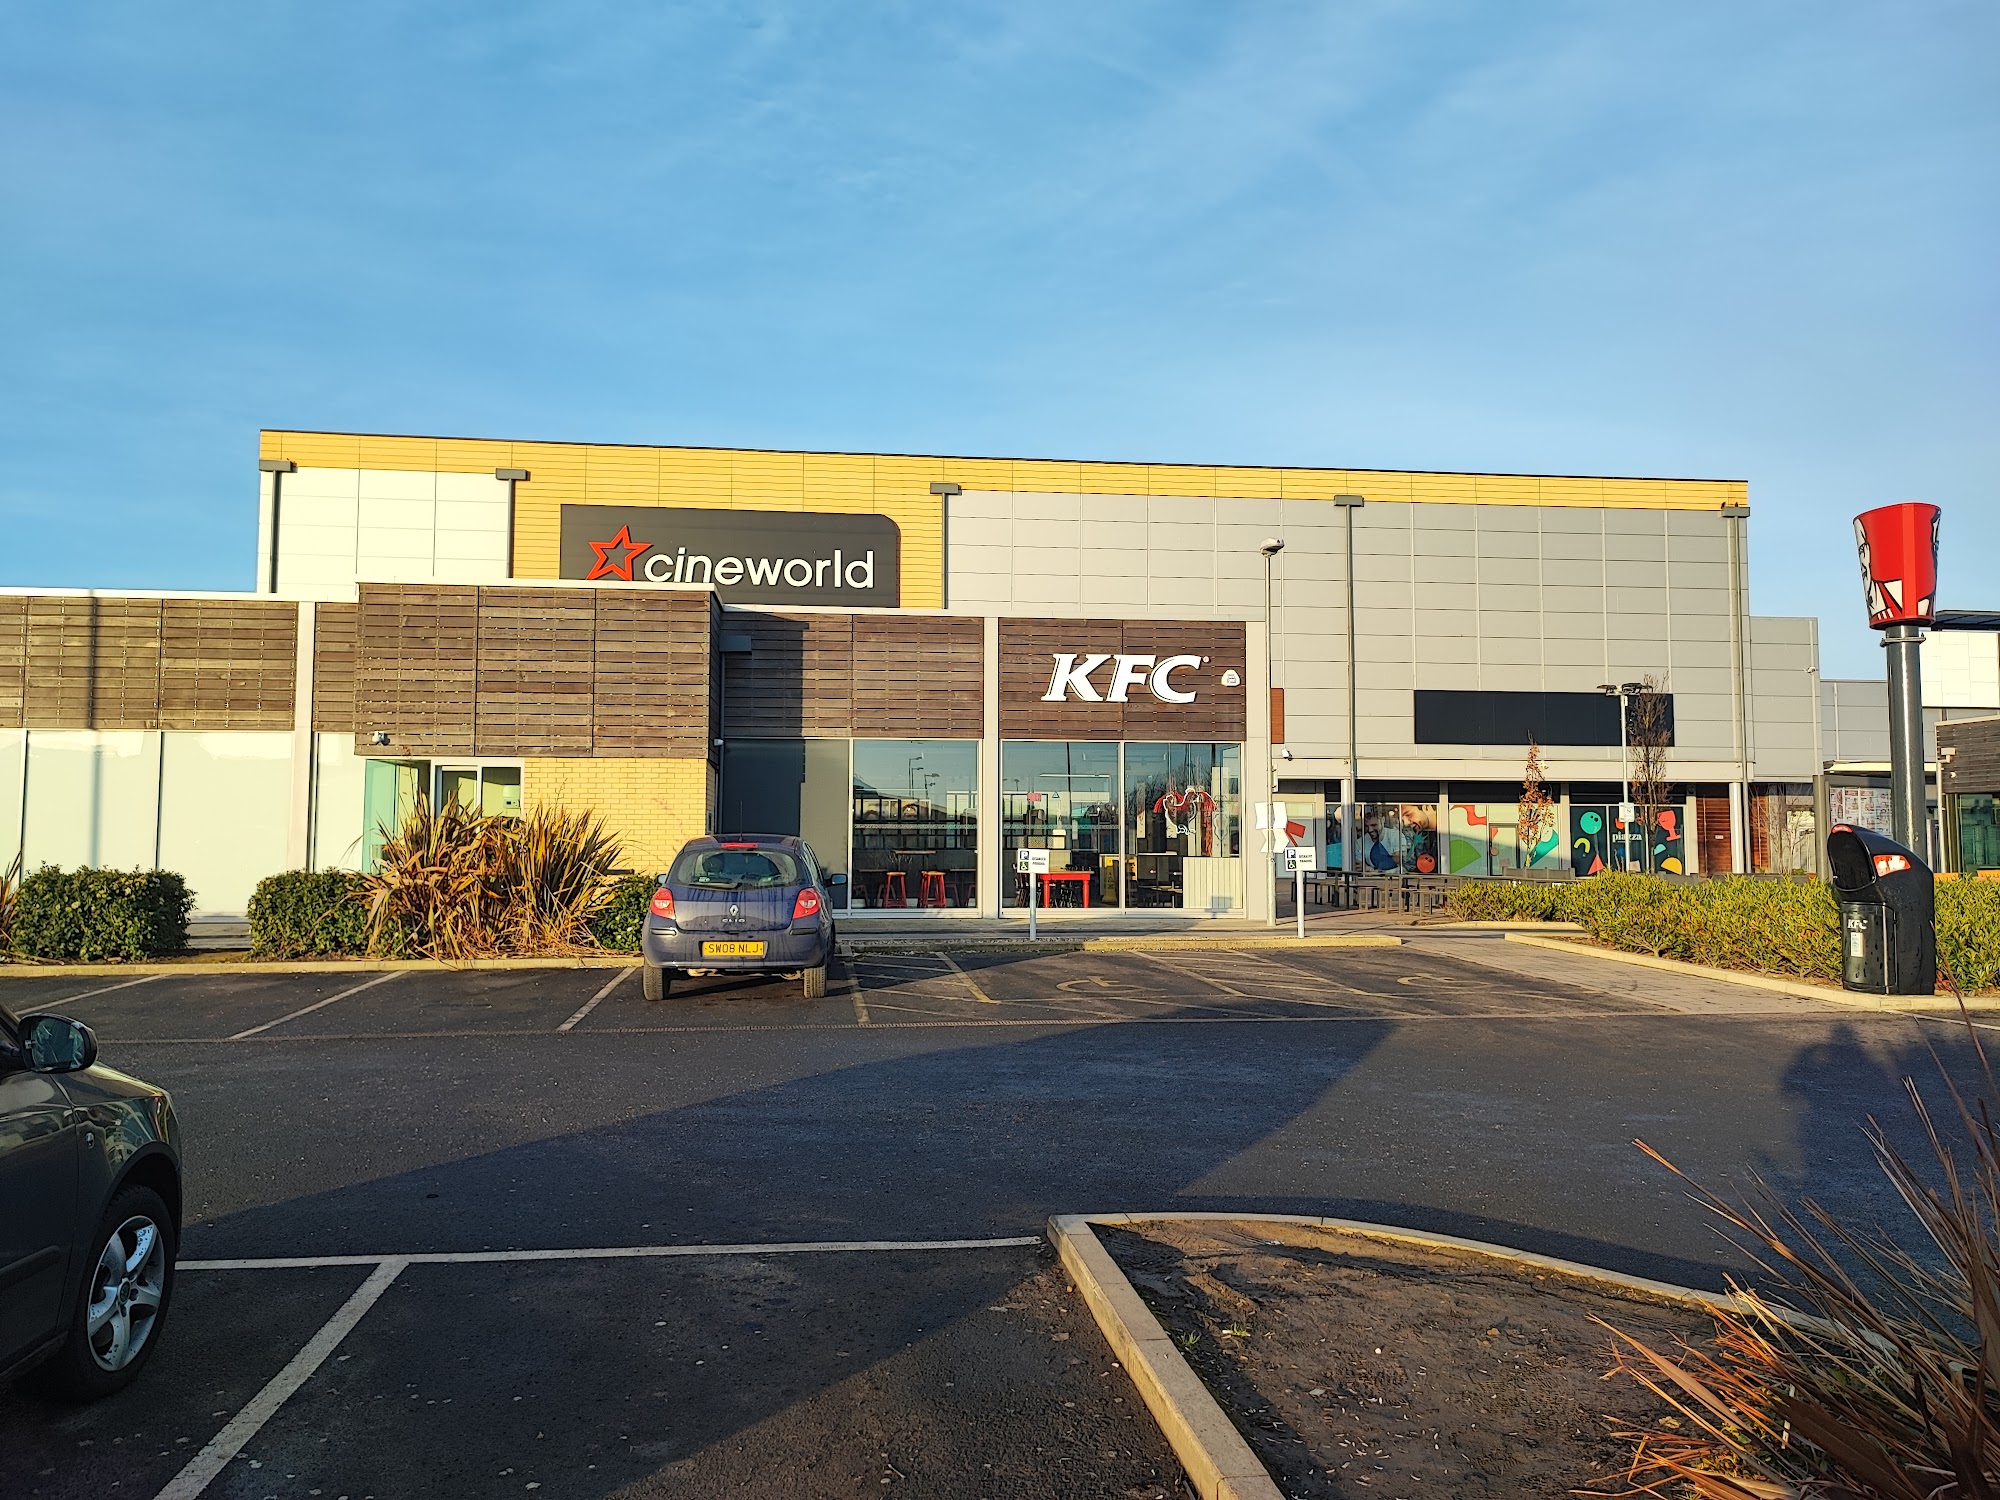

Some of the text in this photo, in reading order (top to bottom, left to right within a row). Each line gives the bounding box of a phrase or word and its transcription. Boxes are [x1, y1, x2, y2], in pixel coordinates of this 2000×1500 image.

[644, 547, 875, 589] cineworld
[1041, 653, 1202, 704] KFC
[1847, 919, 1868, 929] KFC
[708, 943, 759, 953] SW08 NLJ
